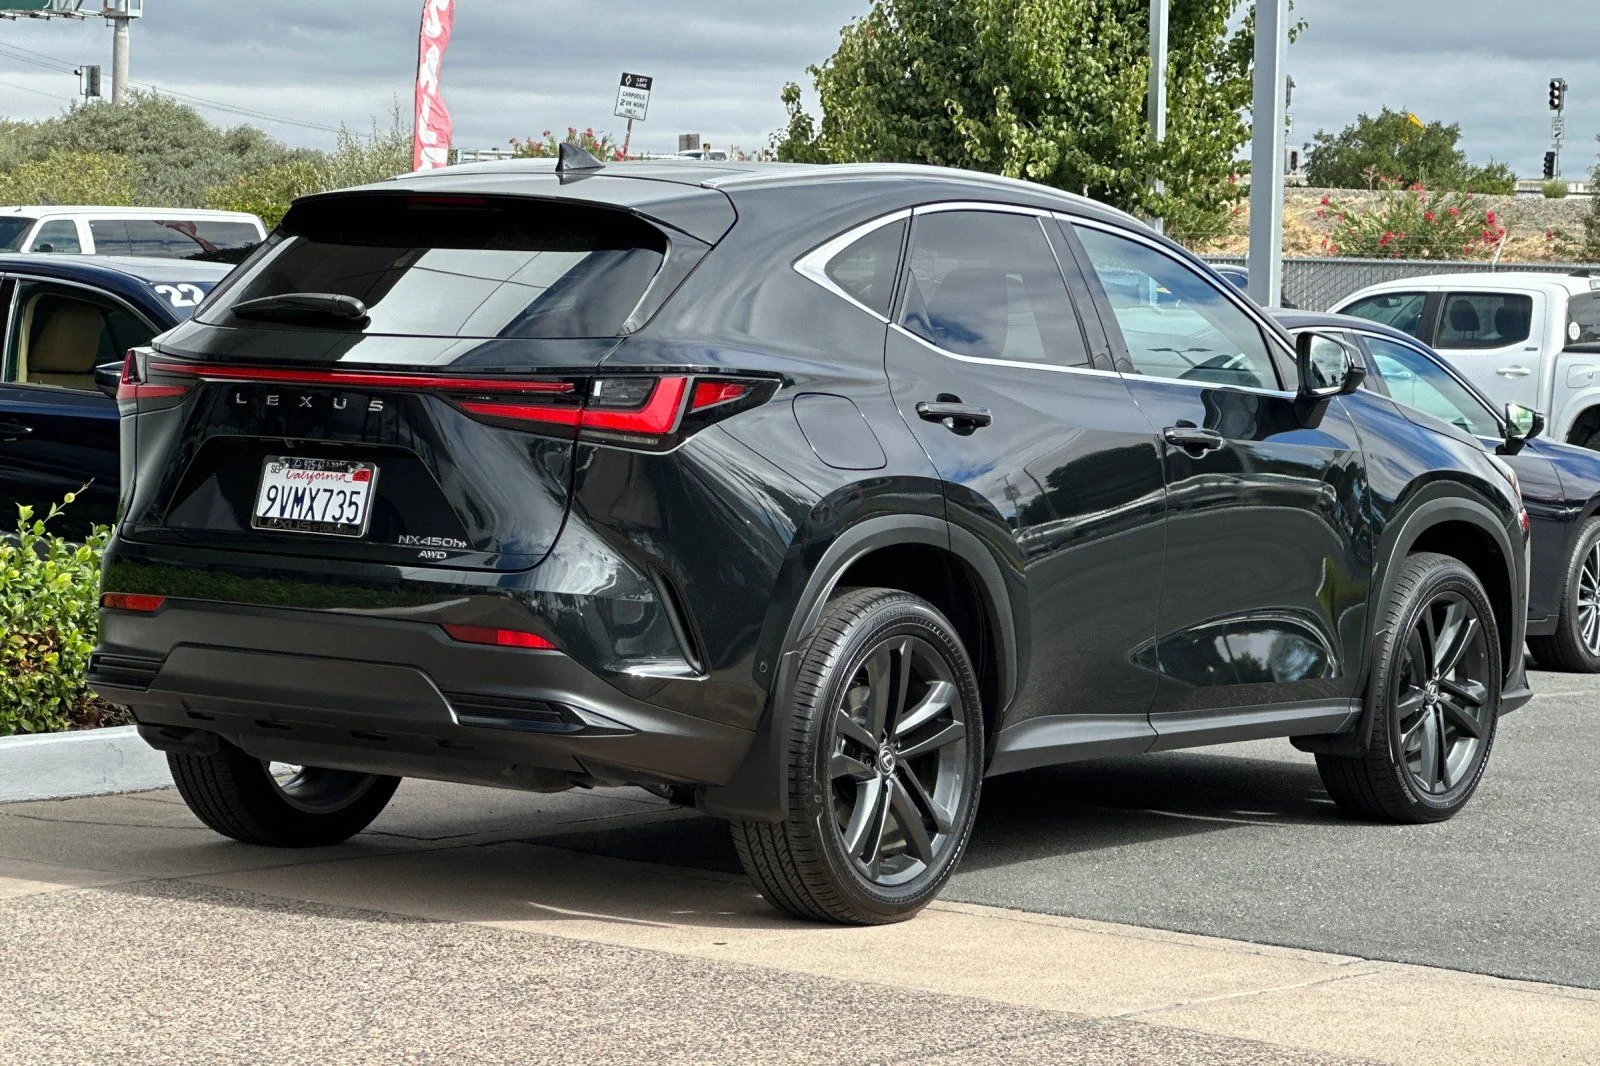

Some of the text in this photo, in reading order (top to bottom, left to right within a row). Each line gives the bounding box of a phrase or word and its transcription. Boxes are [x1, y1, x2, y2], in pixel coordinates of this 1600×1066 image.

[235, 392, 384, 412] LEXUS
[286, 469, 349, 486] California
[261, 484, 362, 523] 9VMX735
[417, 549, 447, 559] AWD
